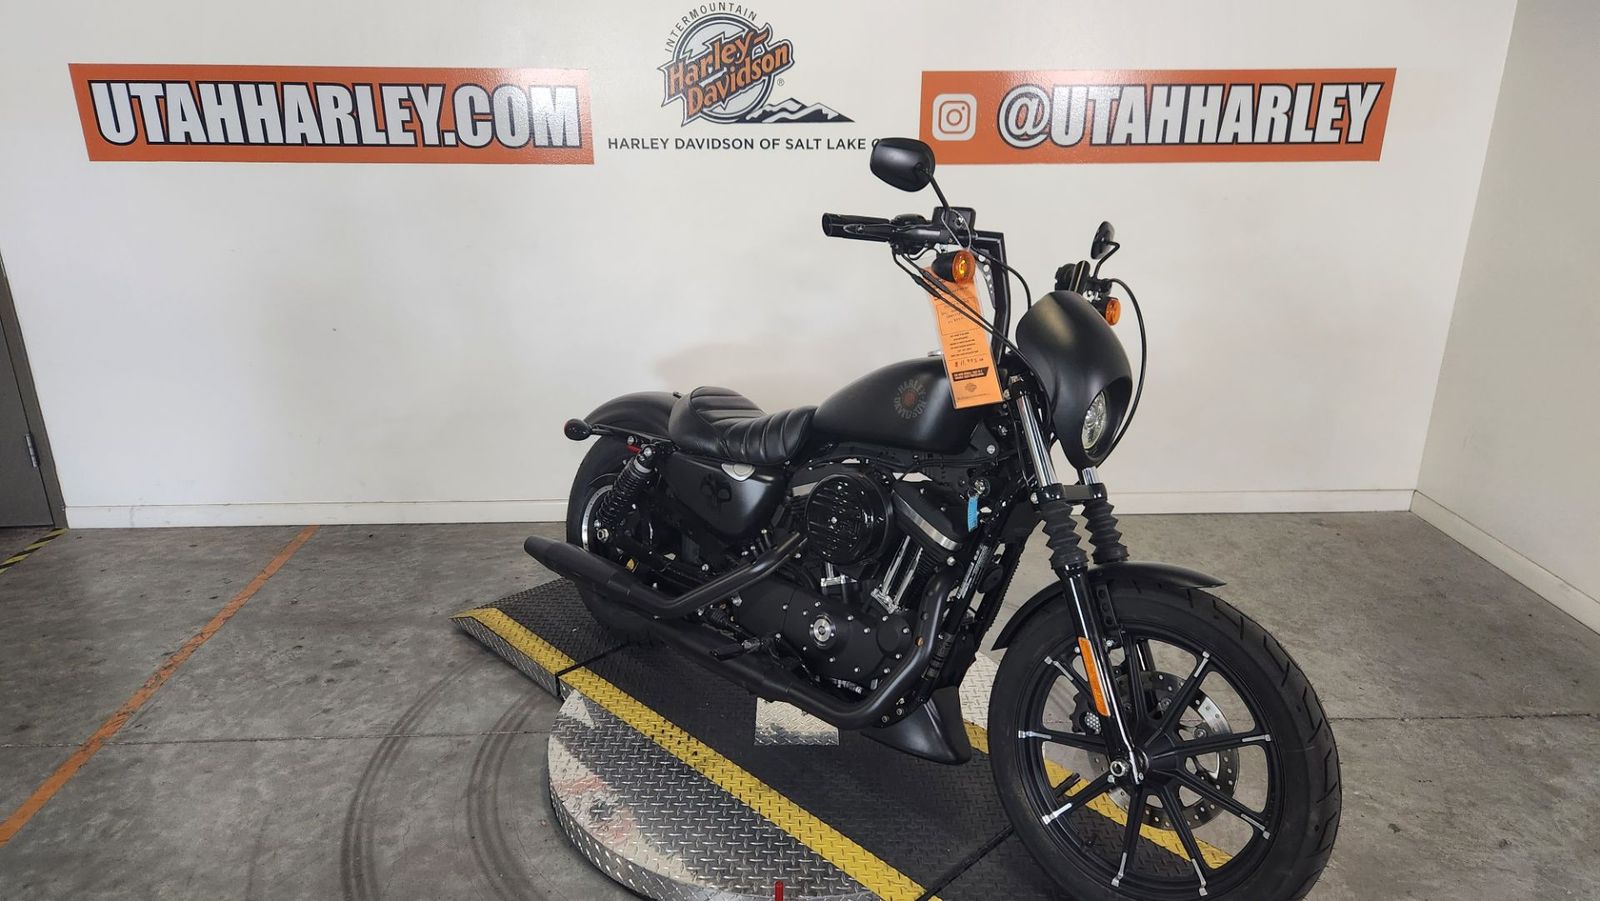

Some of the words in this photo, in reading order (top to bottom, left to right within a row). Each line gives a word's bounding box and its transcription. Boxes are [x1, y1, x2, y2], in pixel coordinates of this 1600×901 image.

[665, 2, 757, 53] INTERMOUNTAIN
[87, 79, 582, 149] UTAHHARLEY.COM
[687, 45, 788, 117] Davidson
[997, 81, 1386, 149] @UTAHHARLEY
[608, 137, 669, 150] HARLEY
[675, 137, 755, 150] DAVIDSON
[759, 137, 780, 150] OF
[785, 137, 821, 150] SALT
[827, 137, 867, 150] LAKE
